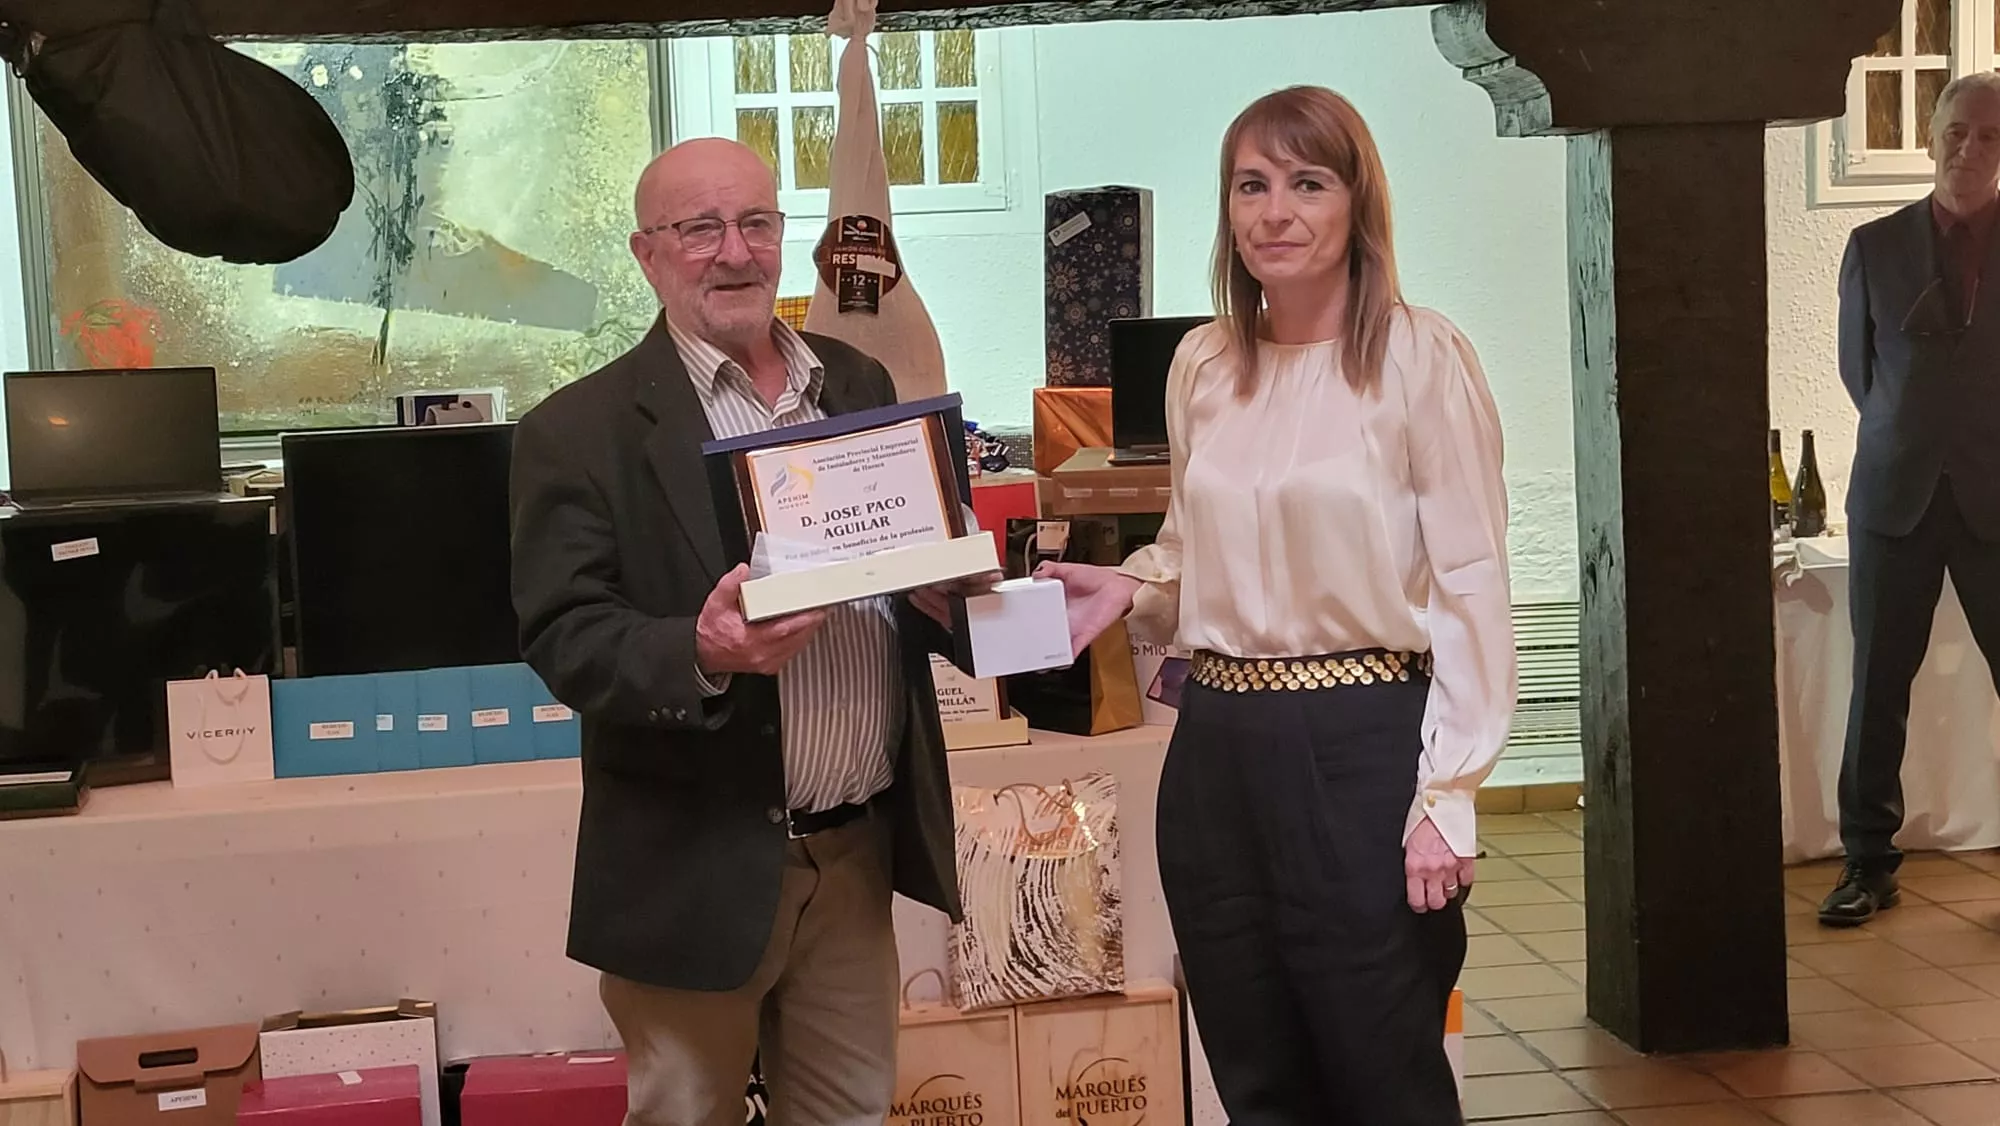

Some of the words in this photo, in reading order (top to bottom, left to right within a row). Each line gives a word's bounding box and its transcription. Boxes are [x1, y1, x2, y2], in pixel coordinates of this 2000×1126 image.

[852, 274, 866, 286] 12
[846, 446, 879, 459] Provincial
[880, 438, 918, 451] Empresarial
[862, 462, 885, 471] Huesca
[800, 515, 817, 528] D.
[822, 505, 862, 523] JOSE
[866, 496, 906, 514] PACO
[824, 515, 891, 540] AGUILAR
[842, 537, 878, 549] beneficio
[879, 534, 890, 542] de
[891, 532, 898, 540] la
[899, 525, 935, 539] profesión
[938, 695, 976, 707] MILLÁN
[1056, 1075, 1146, 1100] MARQUÉS
[889, 1091, 982, 1117] MARQUÉS
[1056, 1108, 1071, 1118] del
[1076, 1095, 1147, 1117] PUERTO
